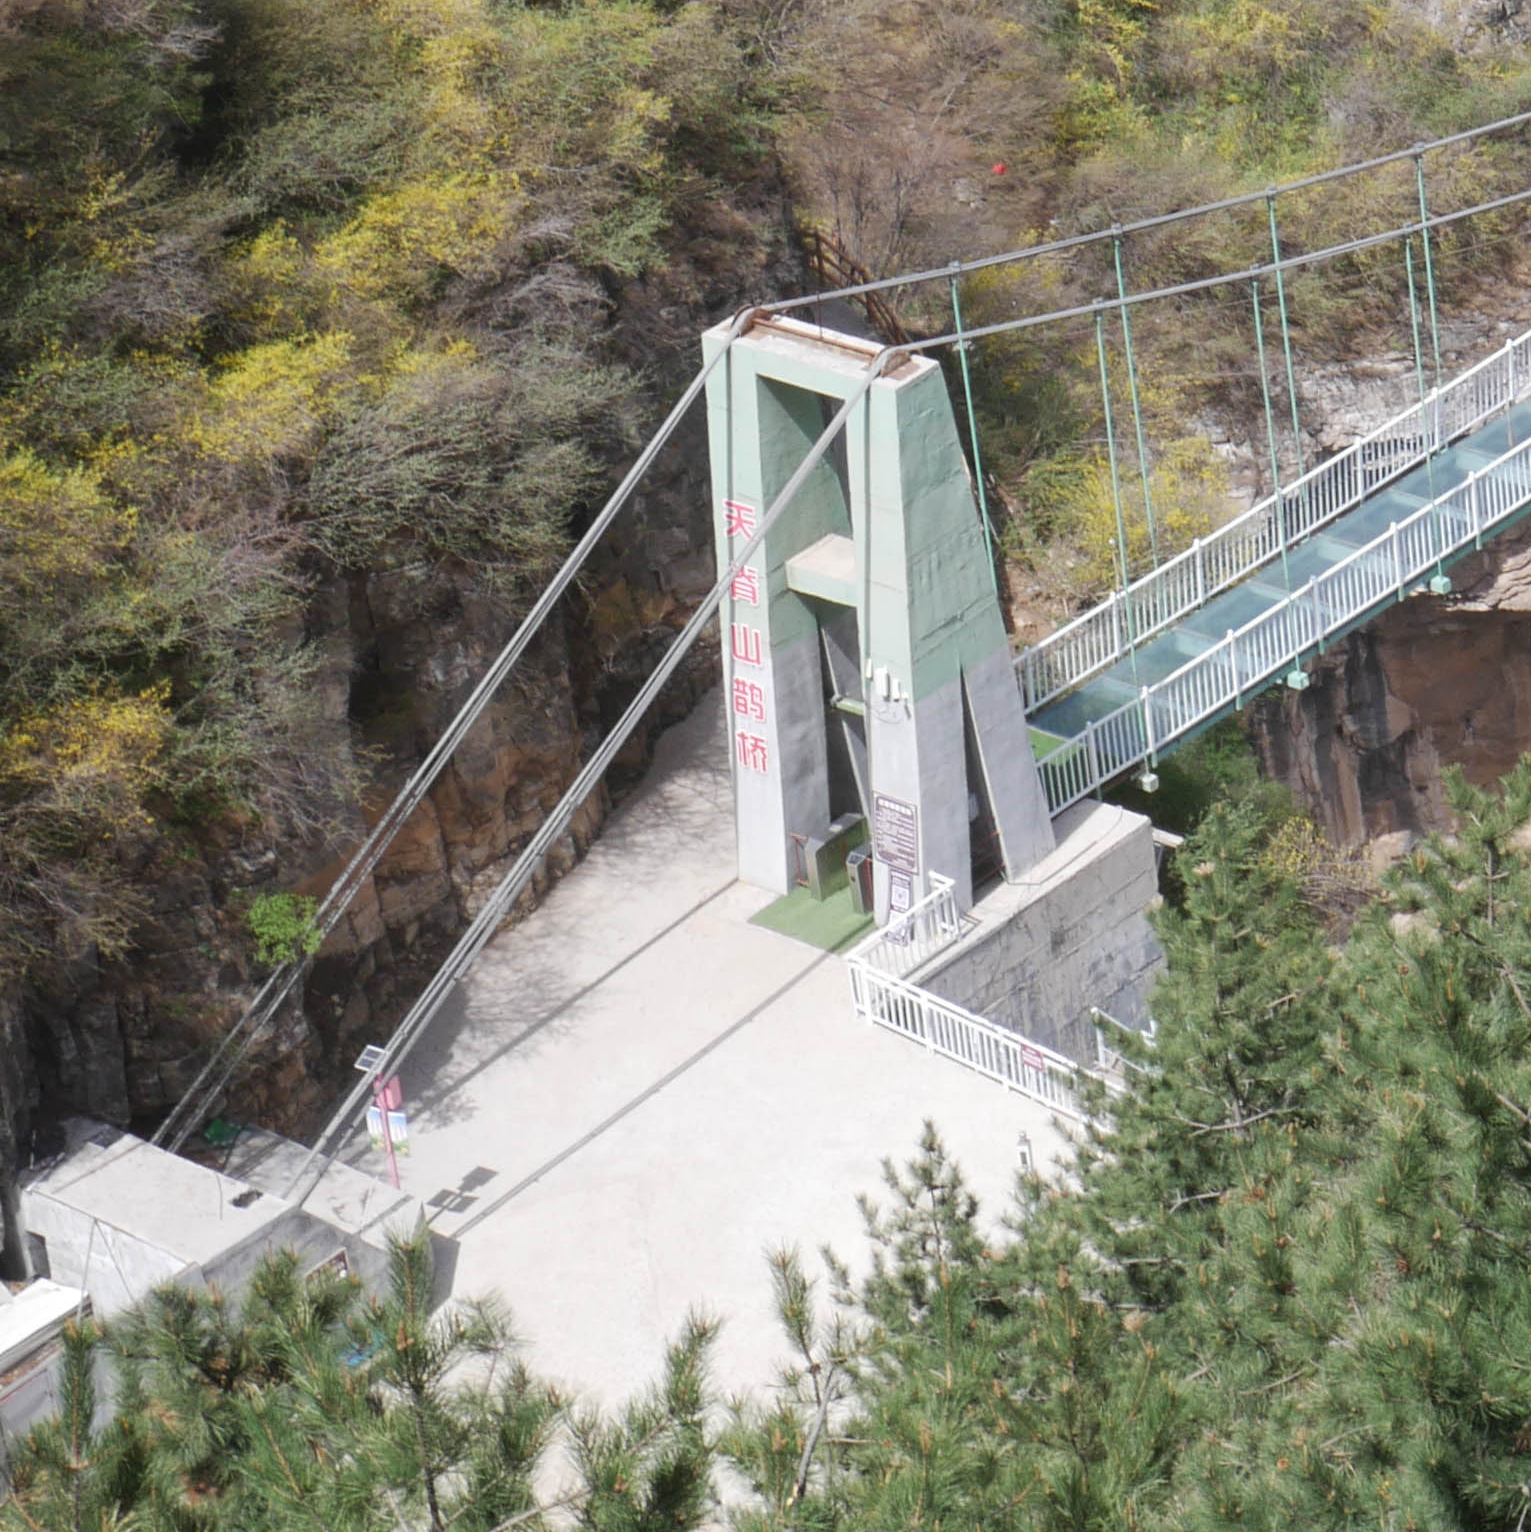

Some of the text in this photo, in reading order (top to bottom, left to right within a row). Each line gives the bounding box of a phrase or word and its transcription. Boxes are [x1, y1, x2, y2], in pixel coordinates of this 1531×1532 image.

[725, 500, 767, 772] 天脊山鹊桥
